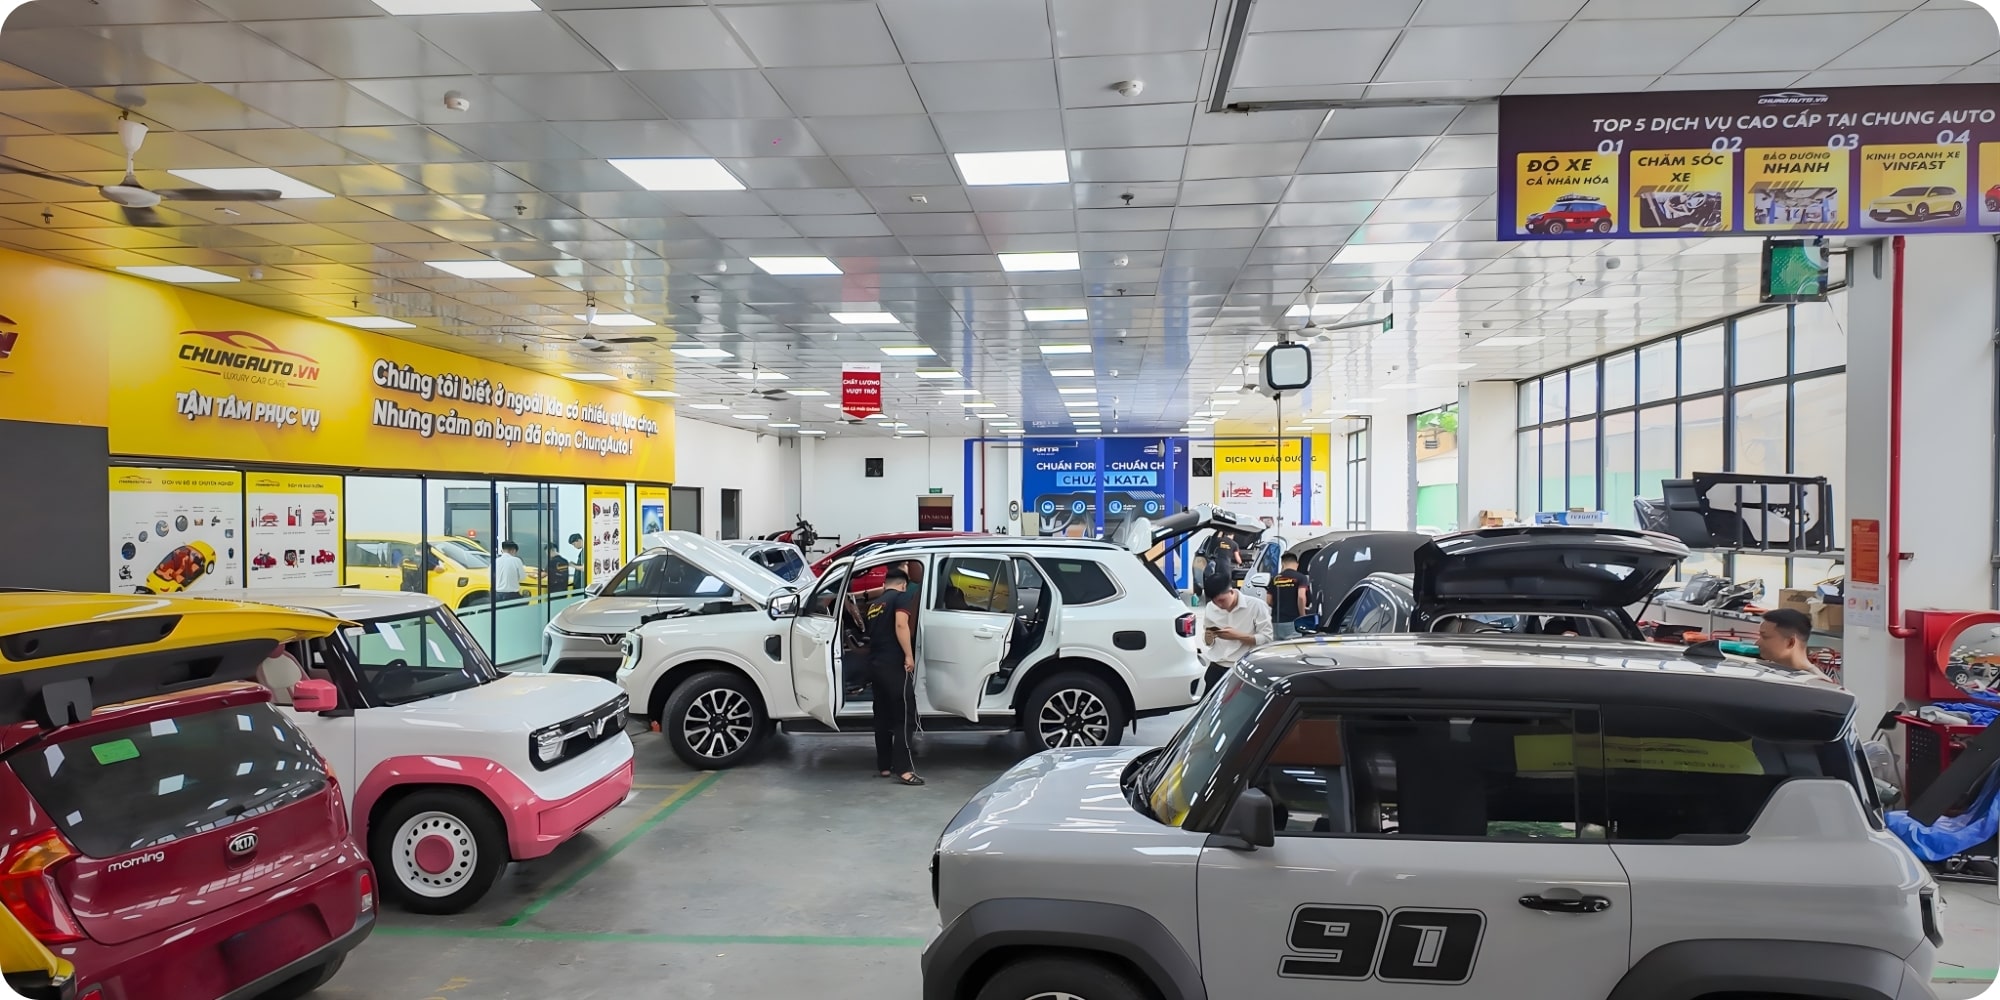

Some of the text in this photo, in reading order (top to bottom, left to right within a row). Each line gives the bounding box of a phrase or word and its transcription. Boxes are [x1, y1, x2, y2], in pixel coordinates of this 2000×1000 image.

[1592, 107, 1996, 134] TOP 5 DỊCH VỤ CAO CẤP TẠI CHUNG AUTO
[1711, 136, 1743, 153] 02
[1828, 133, 1859, 150] 03
[1936, 129, 1970, 146] 04
[1597, 139, 1624, 155] 01
[1866, 150, 1961, 160] KINH DOANH XE
[1526, 155, 1593, 176] ĐỘ XE
[1691, 152, 1725, 165] SÓC
[1882, 160, 1946, 172] VINFAST
[1763, 161, 1830, 174] NHANH
[1526, 174, 1609, 186] CÁ NHÂN HÓA
[1671, 172, 1691, 183] XE
[178, 344, 320, 381] CHUNGAUTO.VN
[222, 372, 286, 389] LUXURY CAR CARE
[372, 358, 435, 402] Chúng
[436, 372, 461, 399] tôi
[462, 376, 492, 406] biết
[494, 381, 506, 408] ở
[546, 395, 563, 418] kia
[566, 400, 579, 421] có
[176, 388, 321, 432] TẬN TÂM PHỤC VỤ
[372, 398, 435, 439] Nhưng
[436, 408, 472, 437] cảm
[474, 418, 493, 439] ơn
[495, 417, 523, 448] bạn
[525, 423, 543, 445] đã
[544, 427, 572, 452] chọn
[1074, 462, 1096, 471] FOR
[1150, 461, 1178, 471] CHT
[1225, 456, 1246, 464] DỊCH
[1249, 456, 1261, 464] VỤ
[1114, 475, 1150, 485] KATA
[234, 834, 256, 850] KIA
[107, 850, 165, 873] morning
[1276, 902, 1488, 986] 90
